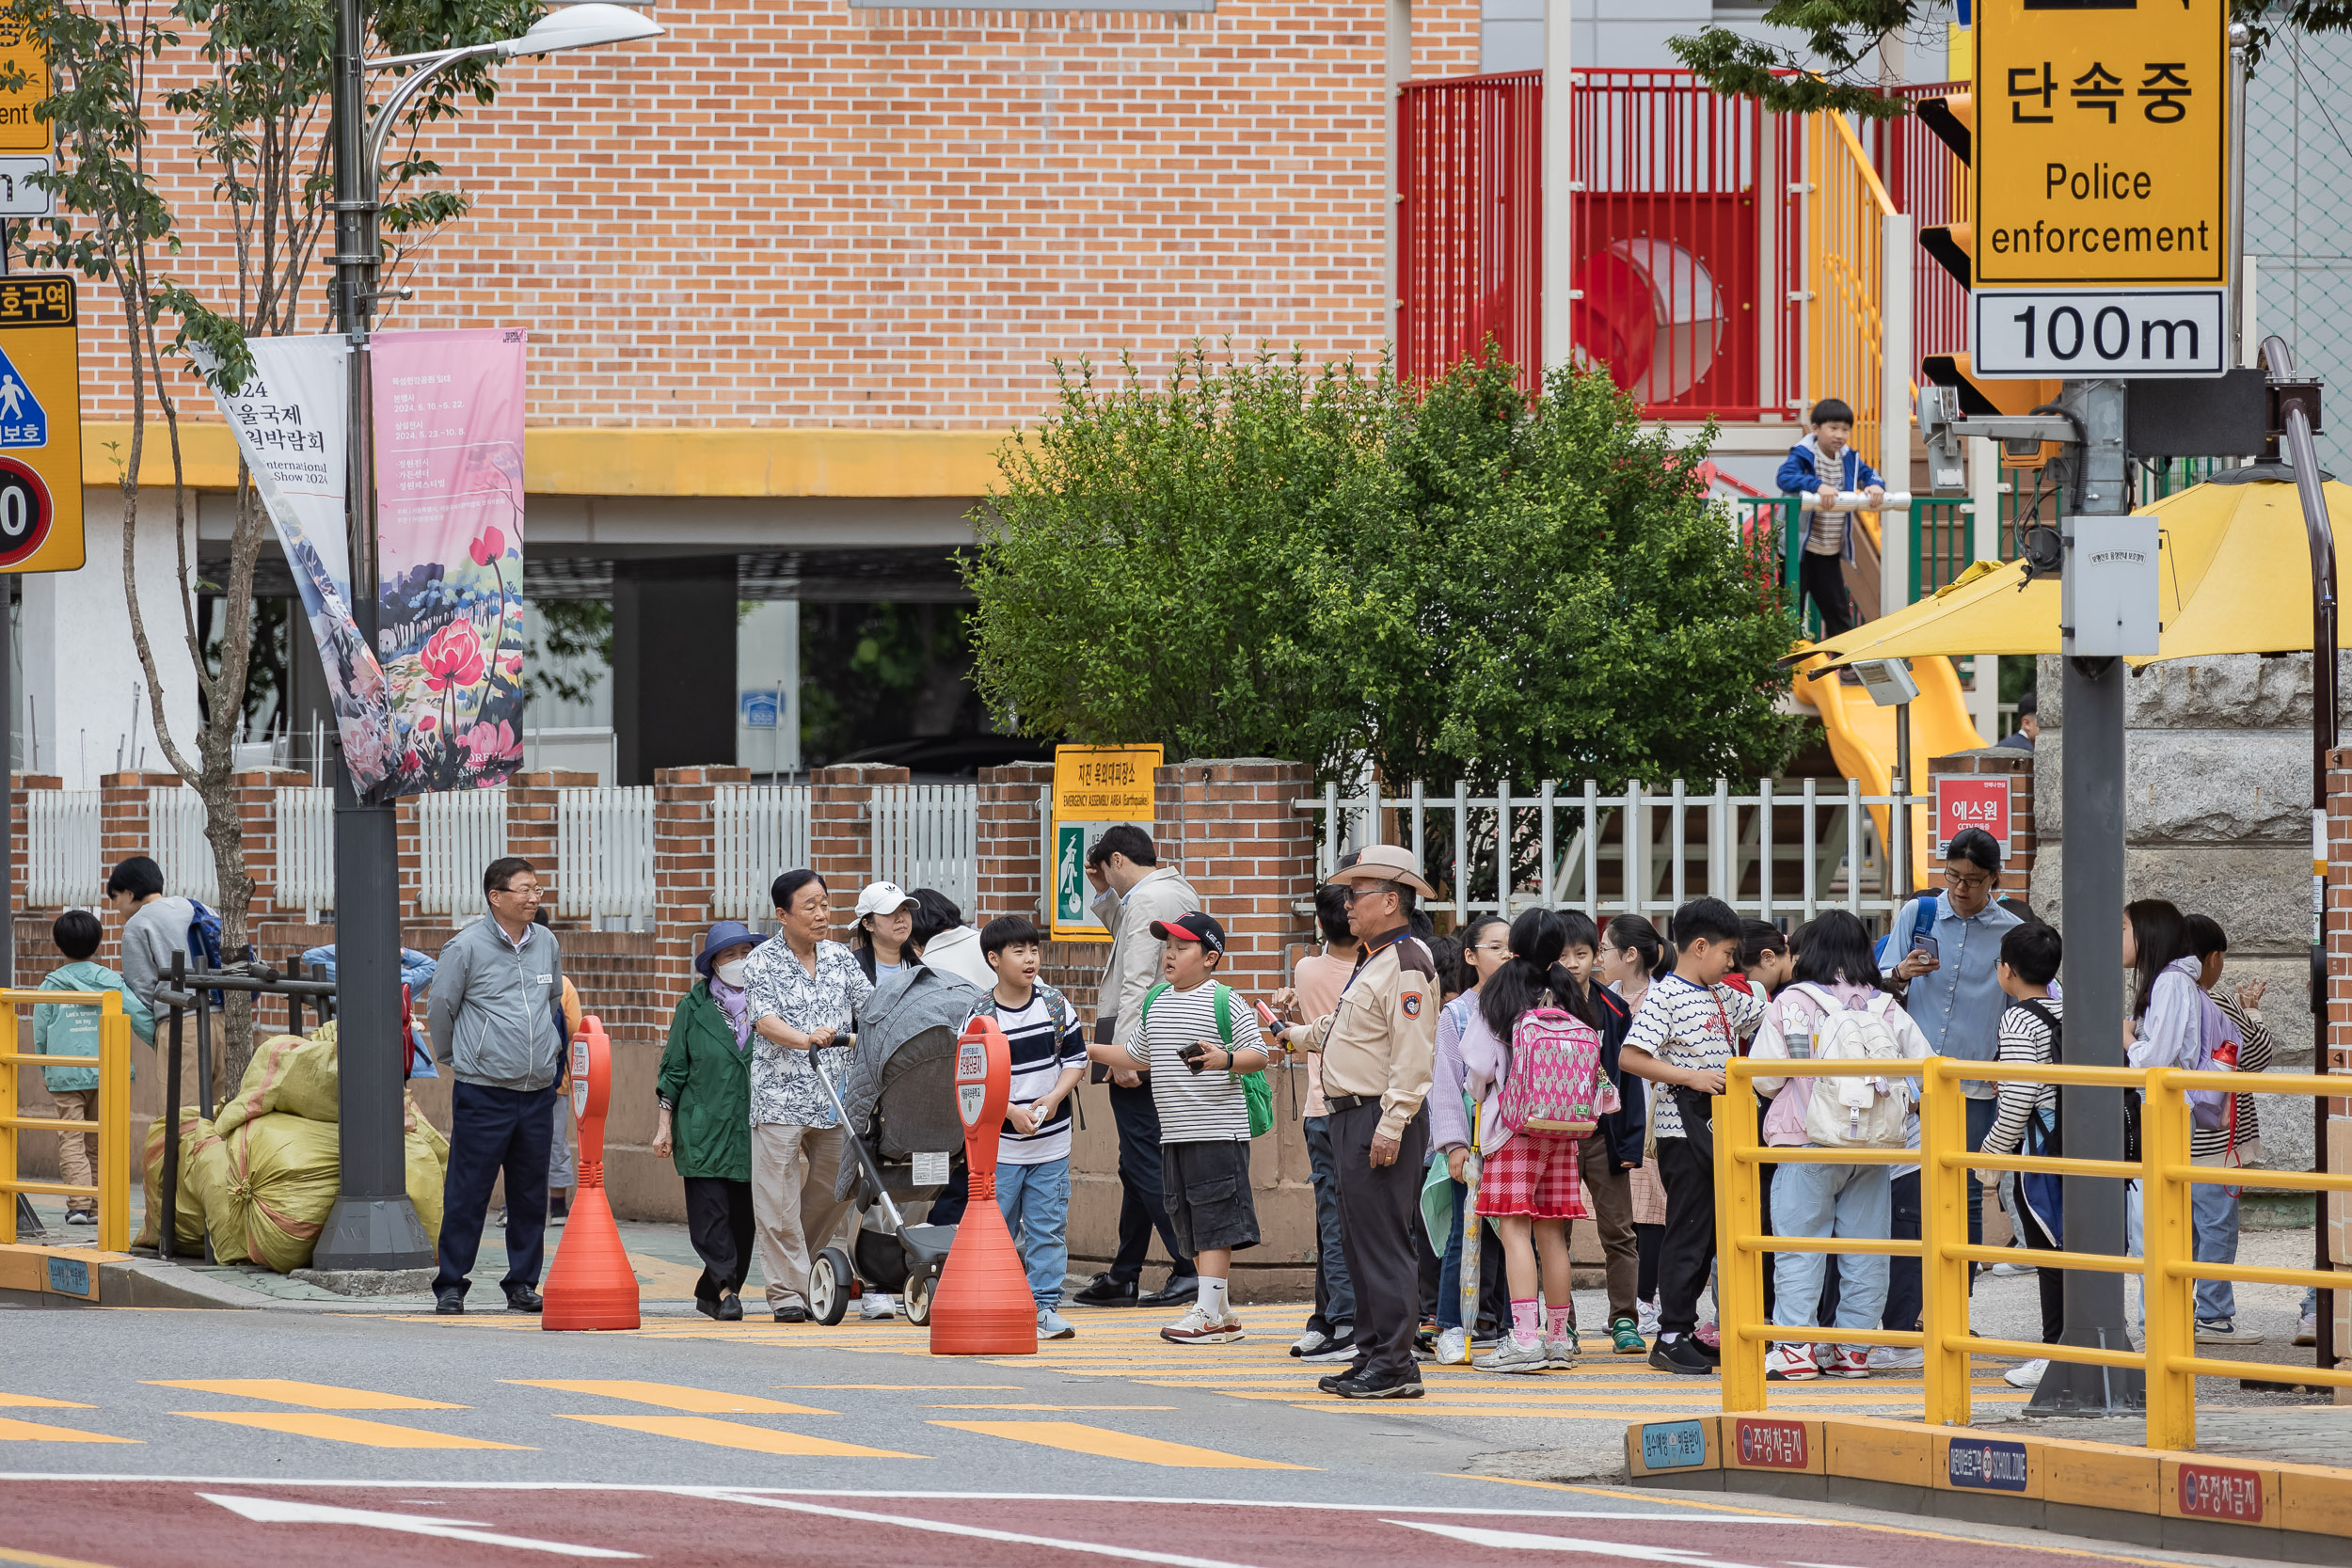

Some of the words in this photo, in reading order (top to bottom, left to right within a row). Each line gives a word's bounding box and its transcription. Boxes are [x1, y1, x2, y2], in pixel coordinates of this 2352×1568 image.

[2008, 61, 2192, 124] 단속중
[2046, 163, 2152, 199] Police
[1992, 220, 2209, 253] enforcement
[2013, 305, 2200, 360] 100m
[0, 423, 41, 444] 보호
[263, 459, 327, 474] nternational
[274, 470, 303, 483] Show
[1078, 763, 1092, 786] 지진
[1094, 761, 1136, 787] 옥외대피장소
[1064, 795, 1088, 807] EMERGENCY
[1089, 795, 1110, 806] ASSEMBLY
[1111, 794, 1122, 806] AREA
[1951, 800, 1997, 820] 에스원
[1645, 1432, 1668, 1458] 침수예방
[1678, 1429, 1702, 1454] 빗물받이
[1754, 1427, 1802, 1463] 주정차금지
[2199, 1475, 2256, 1514] 주정차금지
